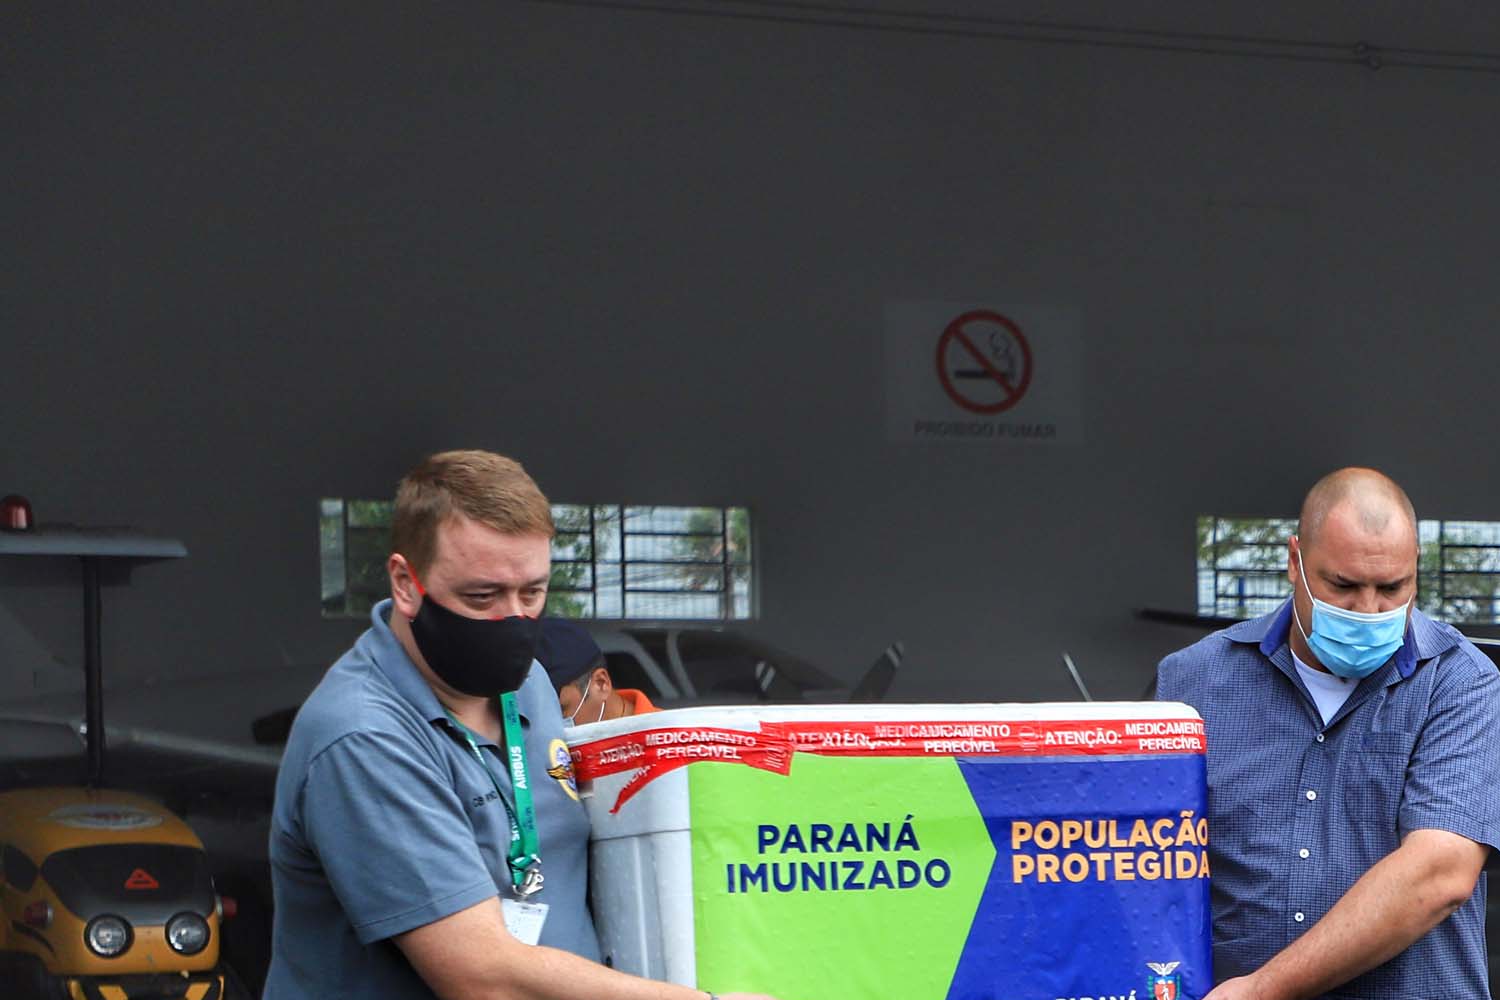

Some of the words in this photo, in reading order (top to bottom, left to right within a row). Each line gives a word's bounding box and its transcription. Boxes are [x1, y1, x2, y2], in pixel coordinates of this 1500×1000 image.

[645, 730, 757, 747] MEDICAMENTO
[924, 737, 1000, 753] PERECÍVEL
[1045, 727, 1123, 748] ATENÇÃO:
[1138, 735, 1203, 751] PERECÍVEL
[656, 744, 742, 760] PERECÍVEL
[510, 745, 528, 790] AIRBUS
[758, 814, 921, 854] PARANÁ
[1011, 810, 1209, 851] POPULAÇÃO
[727, 858, 952, 893] IMUNIZADO
[1012, 850, 1210, 884] PROTEGIDA
